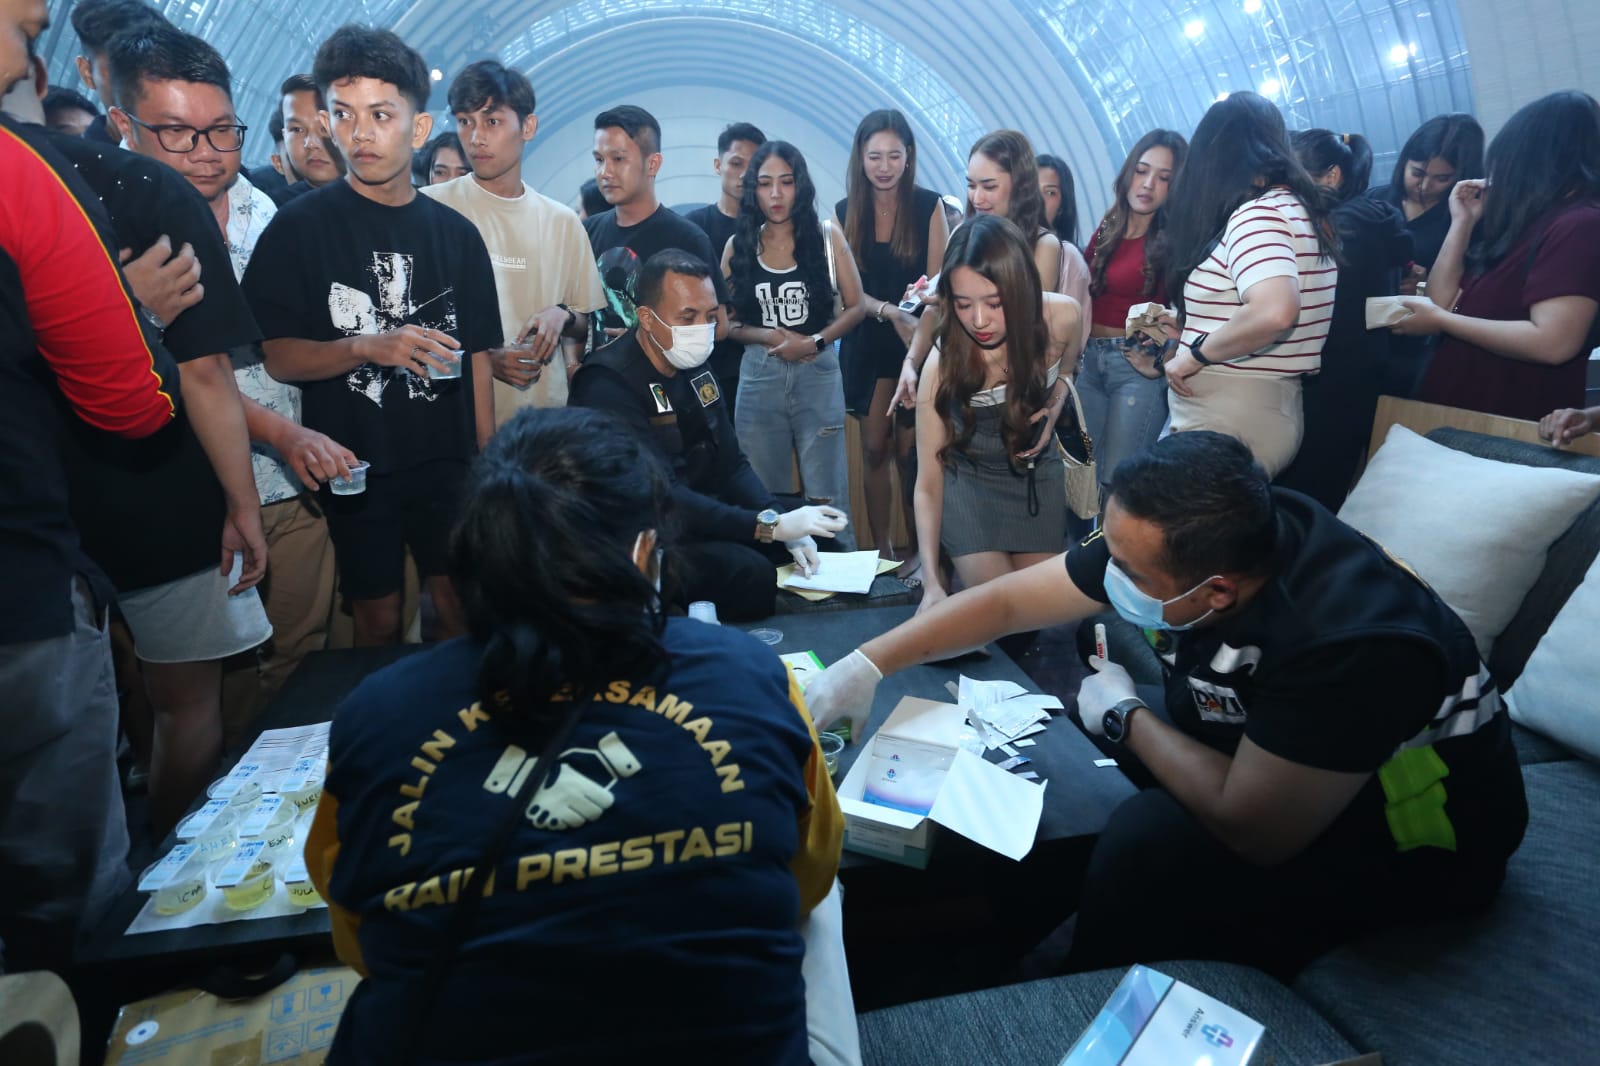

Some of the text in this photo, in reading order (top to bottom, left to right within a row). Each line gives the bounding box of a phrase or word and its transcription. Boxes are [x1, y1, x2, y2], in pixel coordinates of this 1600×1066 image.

[388, 680, 746, 856] JALIN KSAMAAN
[517, 821, 753, 891] PRESTASI
[1181, 1008, 1205, 1039] Answer
